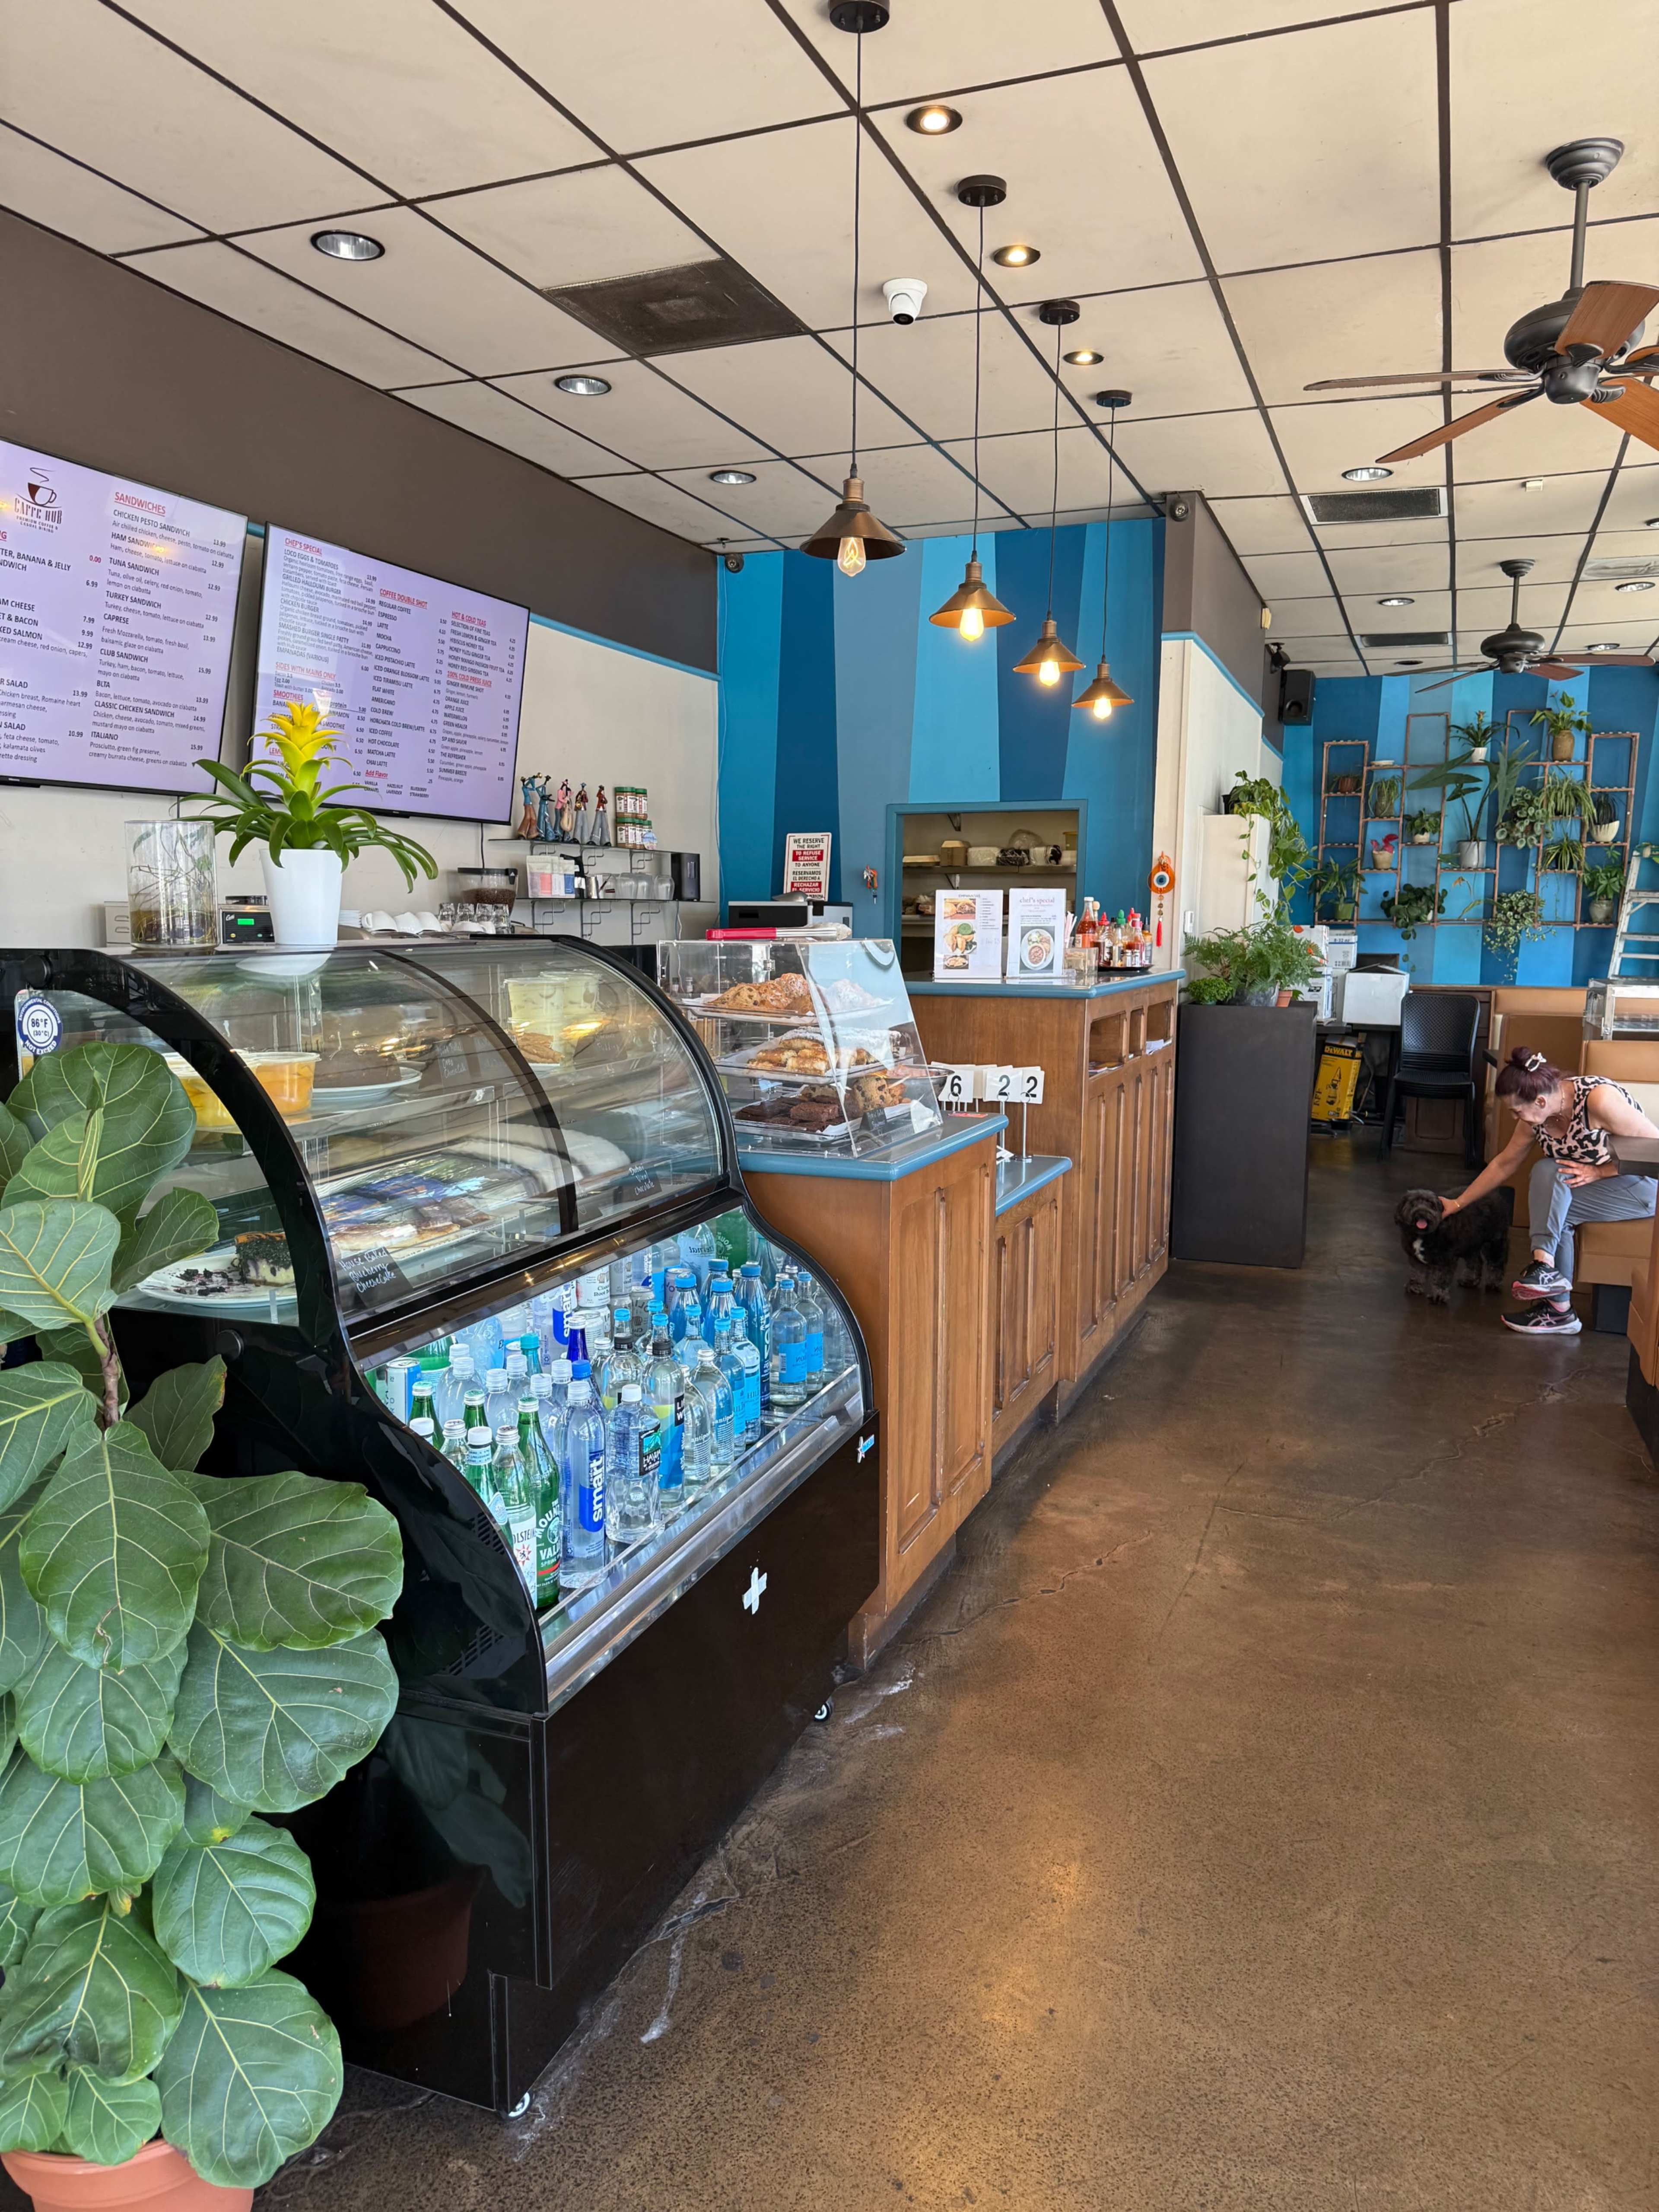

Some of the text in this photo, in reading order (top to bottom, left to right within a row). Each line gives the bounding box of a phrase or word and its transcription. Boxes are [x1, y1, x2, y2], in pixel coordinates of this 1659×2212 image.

[114, 492, 166, 514] SANDWICHES
[45, 510, 62, 524] HUB
[113, 509, 226, 547] CHICKEN PESTO SANDWICH 13.99
[111, 532, 127, 542] HAM
[211, 560, 224, 569] 12.99
[285, 538, 322, 555] CHEF'S SPECIAL
[0, 548, 15, 559] TER,
[16, 552, 46, 566] BANANA
[54, 561, 71, 571] JELLY
[89, 555, 102, 563] 0.00
[109, 557, 126, 567] TUNA
[127, 562, 159, 576] SANDWICH
[284, 549, 297, 557] LOCO
[297, 553, 309, 561] EGGS
[315, 558, 339, 570] TOMATOES
[0, 560, 98, 588] NDWICH 6.99
[106, 590, 218, 622] TURKEY SANDWICH 12.99
[280, 598, 319, 613] CHICKEN BURGER
[380, 588, 428, 608] COFFEE DOUBLE SHOT
[10, 600, 95, 624] CHEESE 7.99
[378, 600, 411, 614] REGULAR COFFEE
[103, 613, 129, 624] CAPRESE
[378, 611, 397, 621] ESPRESSO
[465, 615, 476, 623] COLD
[477, 618, 486, 627] TEAS
[14, 615, 38, 627] BACON
[81, 629, 93, 637] 9.99
[13, 628, 93, 649] SALMON 12.99
[376, 632, 392, 642] MOCHA
[100, 648, 115, 657] CLUB
[116, 651, 148, 663] SANDWICH
[6, 679, 28, 688] SALAD
[96, 680, 110, 688] BLTA
[21, 693, 40, 702] breast,
[41, 695, 65, 705] Romaine
[66, 699, 81, 707] heart
[273, 689, 303, 701] SMOOTHIES
[371, 696, 396, 706] AMERICANO
[94, 700, 118, 710] CLASSIC
[118, 704, 143, 713] CHICKEN
[144, 708, 175, 718] SANDWICH
[4, 722, 26, 731] SALAD
[16, 734, 37, 744] cheese,
[38, 737, 59, 746] tomato,
[91, 731, 118, 741] ITALIANO
[377, 739, 400, 748] CHOCOLATE
[89, 741, 116, 751] Prosciutto,
[43, 999, 61, 1024] CONDITIONS
[31, 1018, 48, 1028] 86°F
[25, 1040, 57, 1055] NOT EXCEED
[950, 1075, 962, 1097] 6
[998, 1075, 1011, 1096] 2
[1025, 1076, 1037, 1098] 2
[338, 1247, 388, 1271] House Baked
[349, 1263, 389, 1283] Blueberry
[590, 1455, 604, 1522] smart
